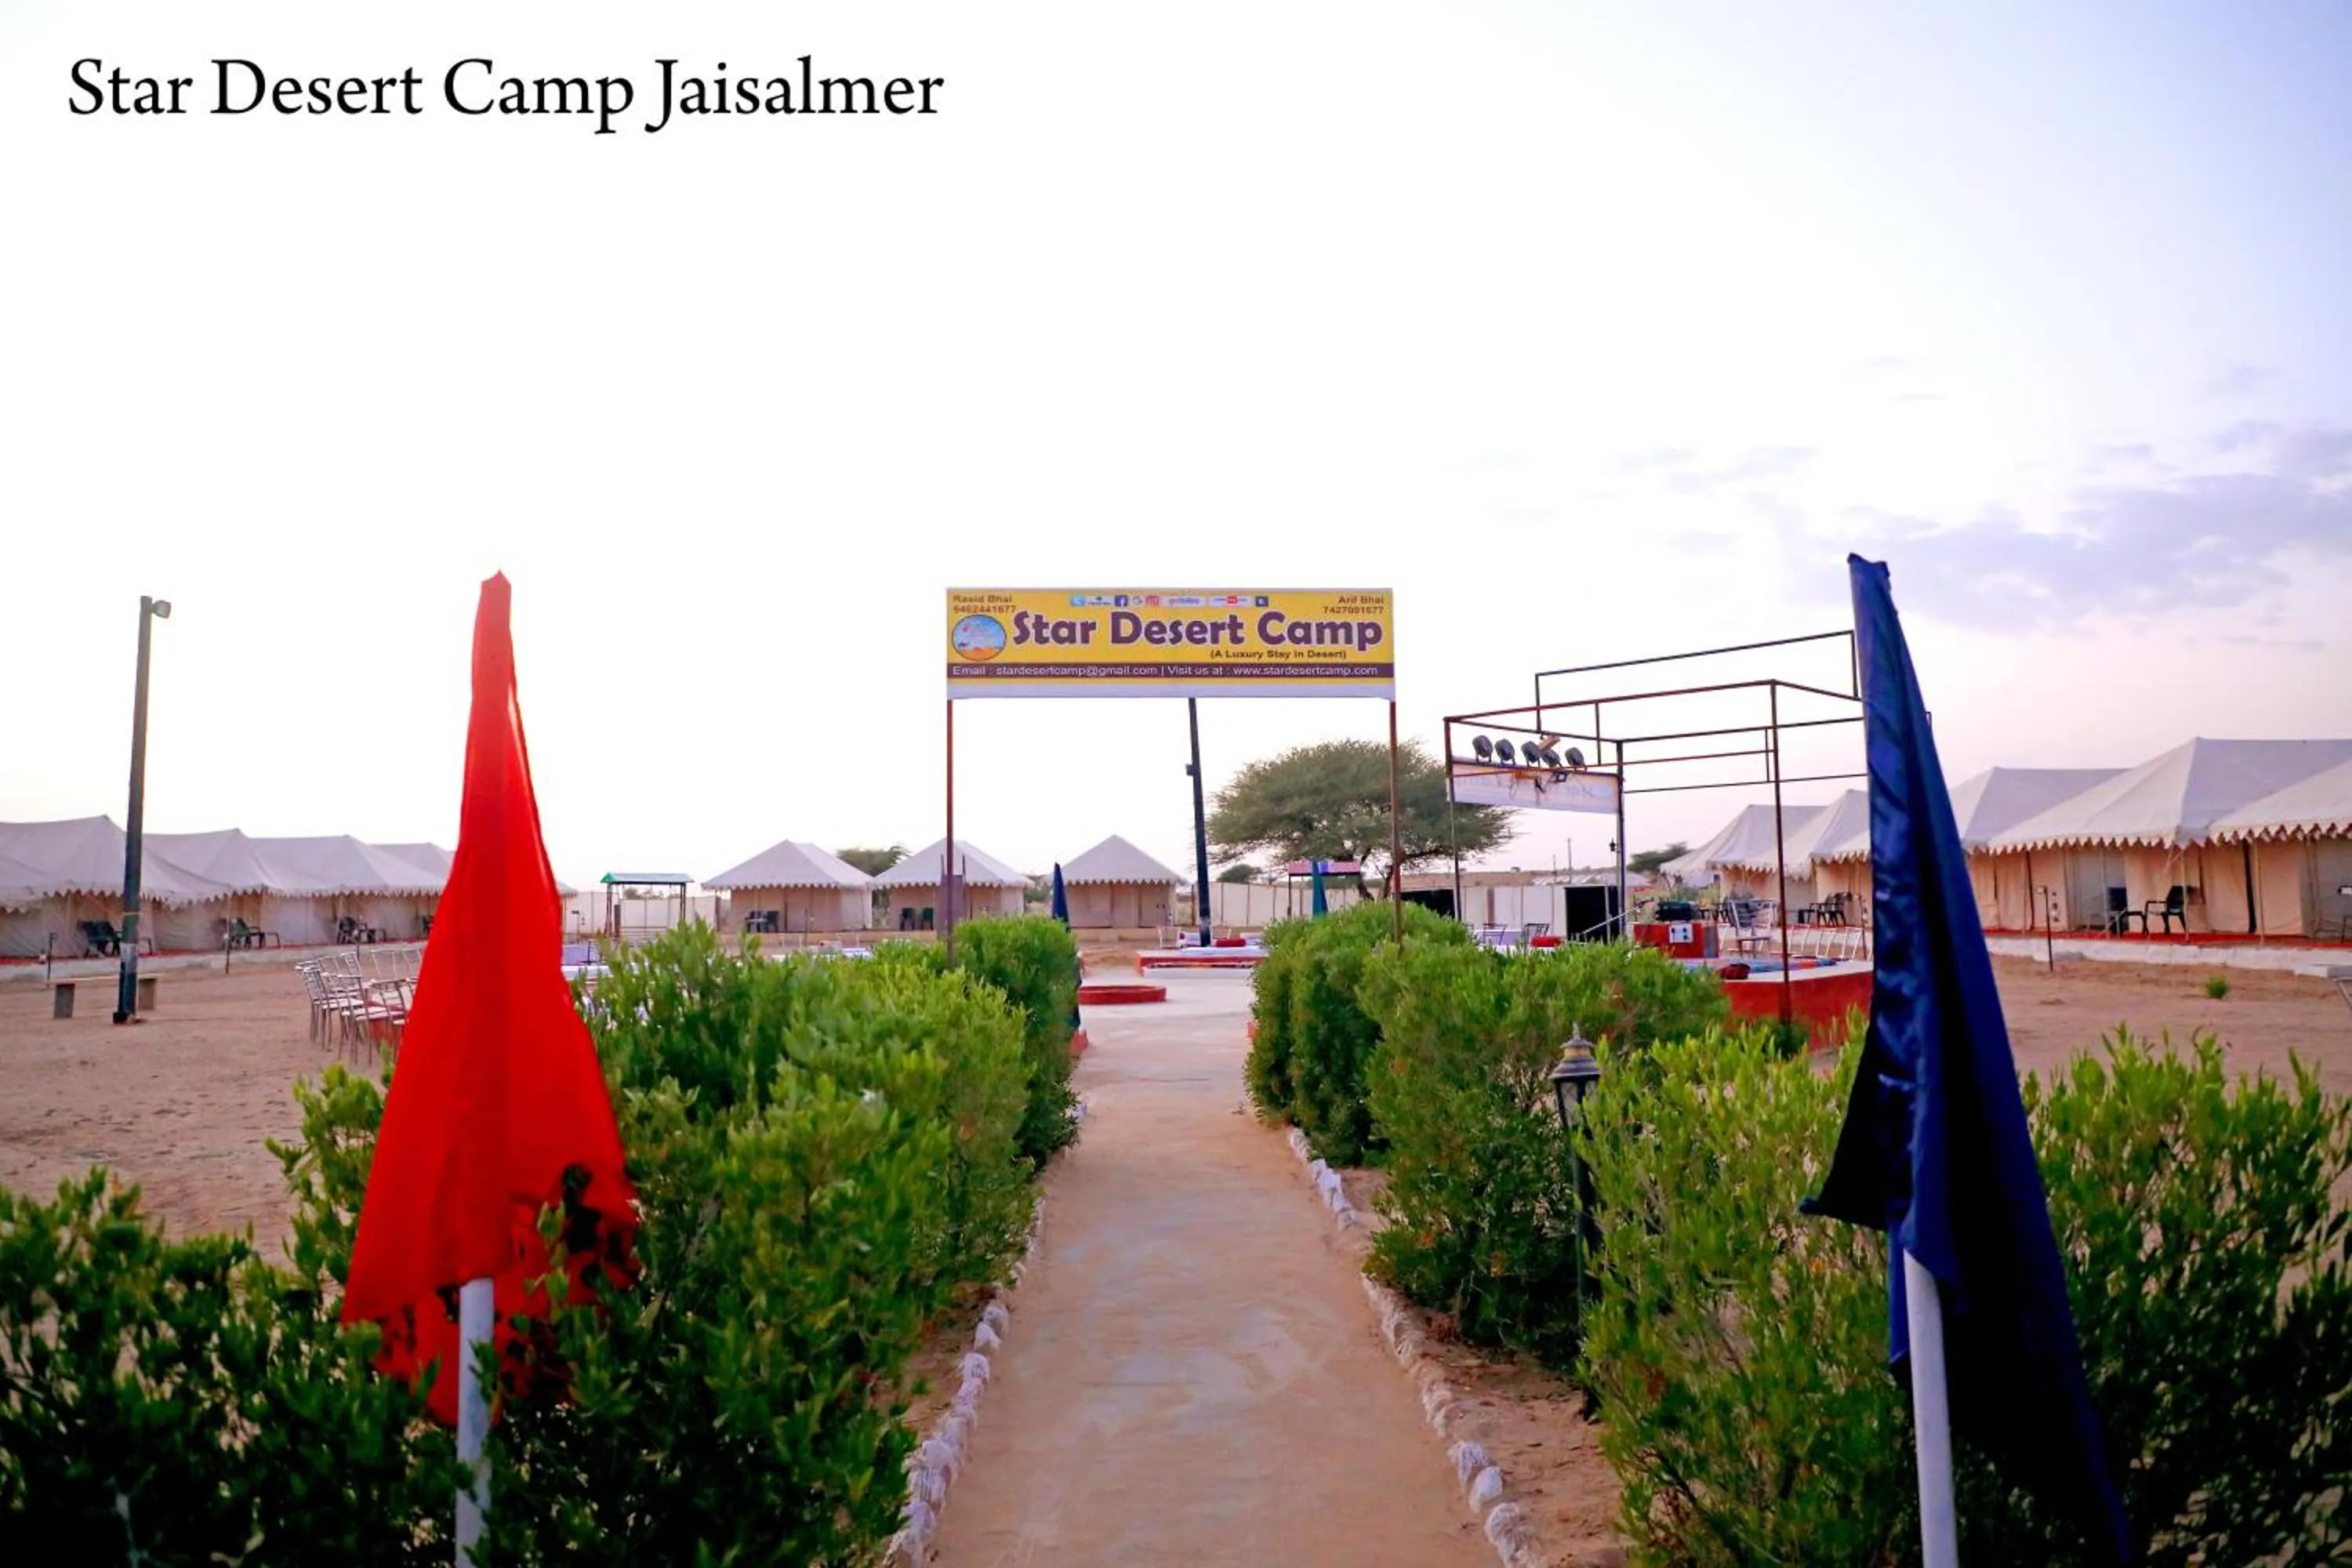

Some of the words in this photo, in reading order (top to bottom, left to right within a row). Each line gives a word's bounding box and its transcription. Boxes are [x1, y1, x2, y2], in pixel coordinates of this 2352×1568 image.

[1338, 595, 1358, 604] Arif
[1360, 595, 1385, 604] Bhai
[1012, 611, 1096, 644] Star
[1110, 611, 1244, 645] Desert
[1257, 611, 1383, 651] Camp
[1210, 649, 1221, 659] (A
[1225, 650, 1264, 659] Luxury
[1267, 650, 1292, 659] Stay
[1307, 649, 1347, 659] Desert)
[953, 666, 985, 675] Email
[996, 666, 1157, 677] stardesertcamp@gmail.com
[1167, 666, 1192, 675] Visit
[1211, 666, 1224, 675] at
[1233, 666, 1377, 677] www.stardesertcamp.com
